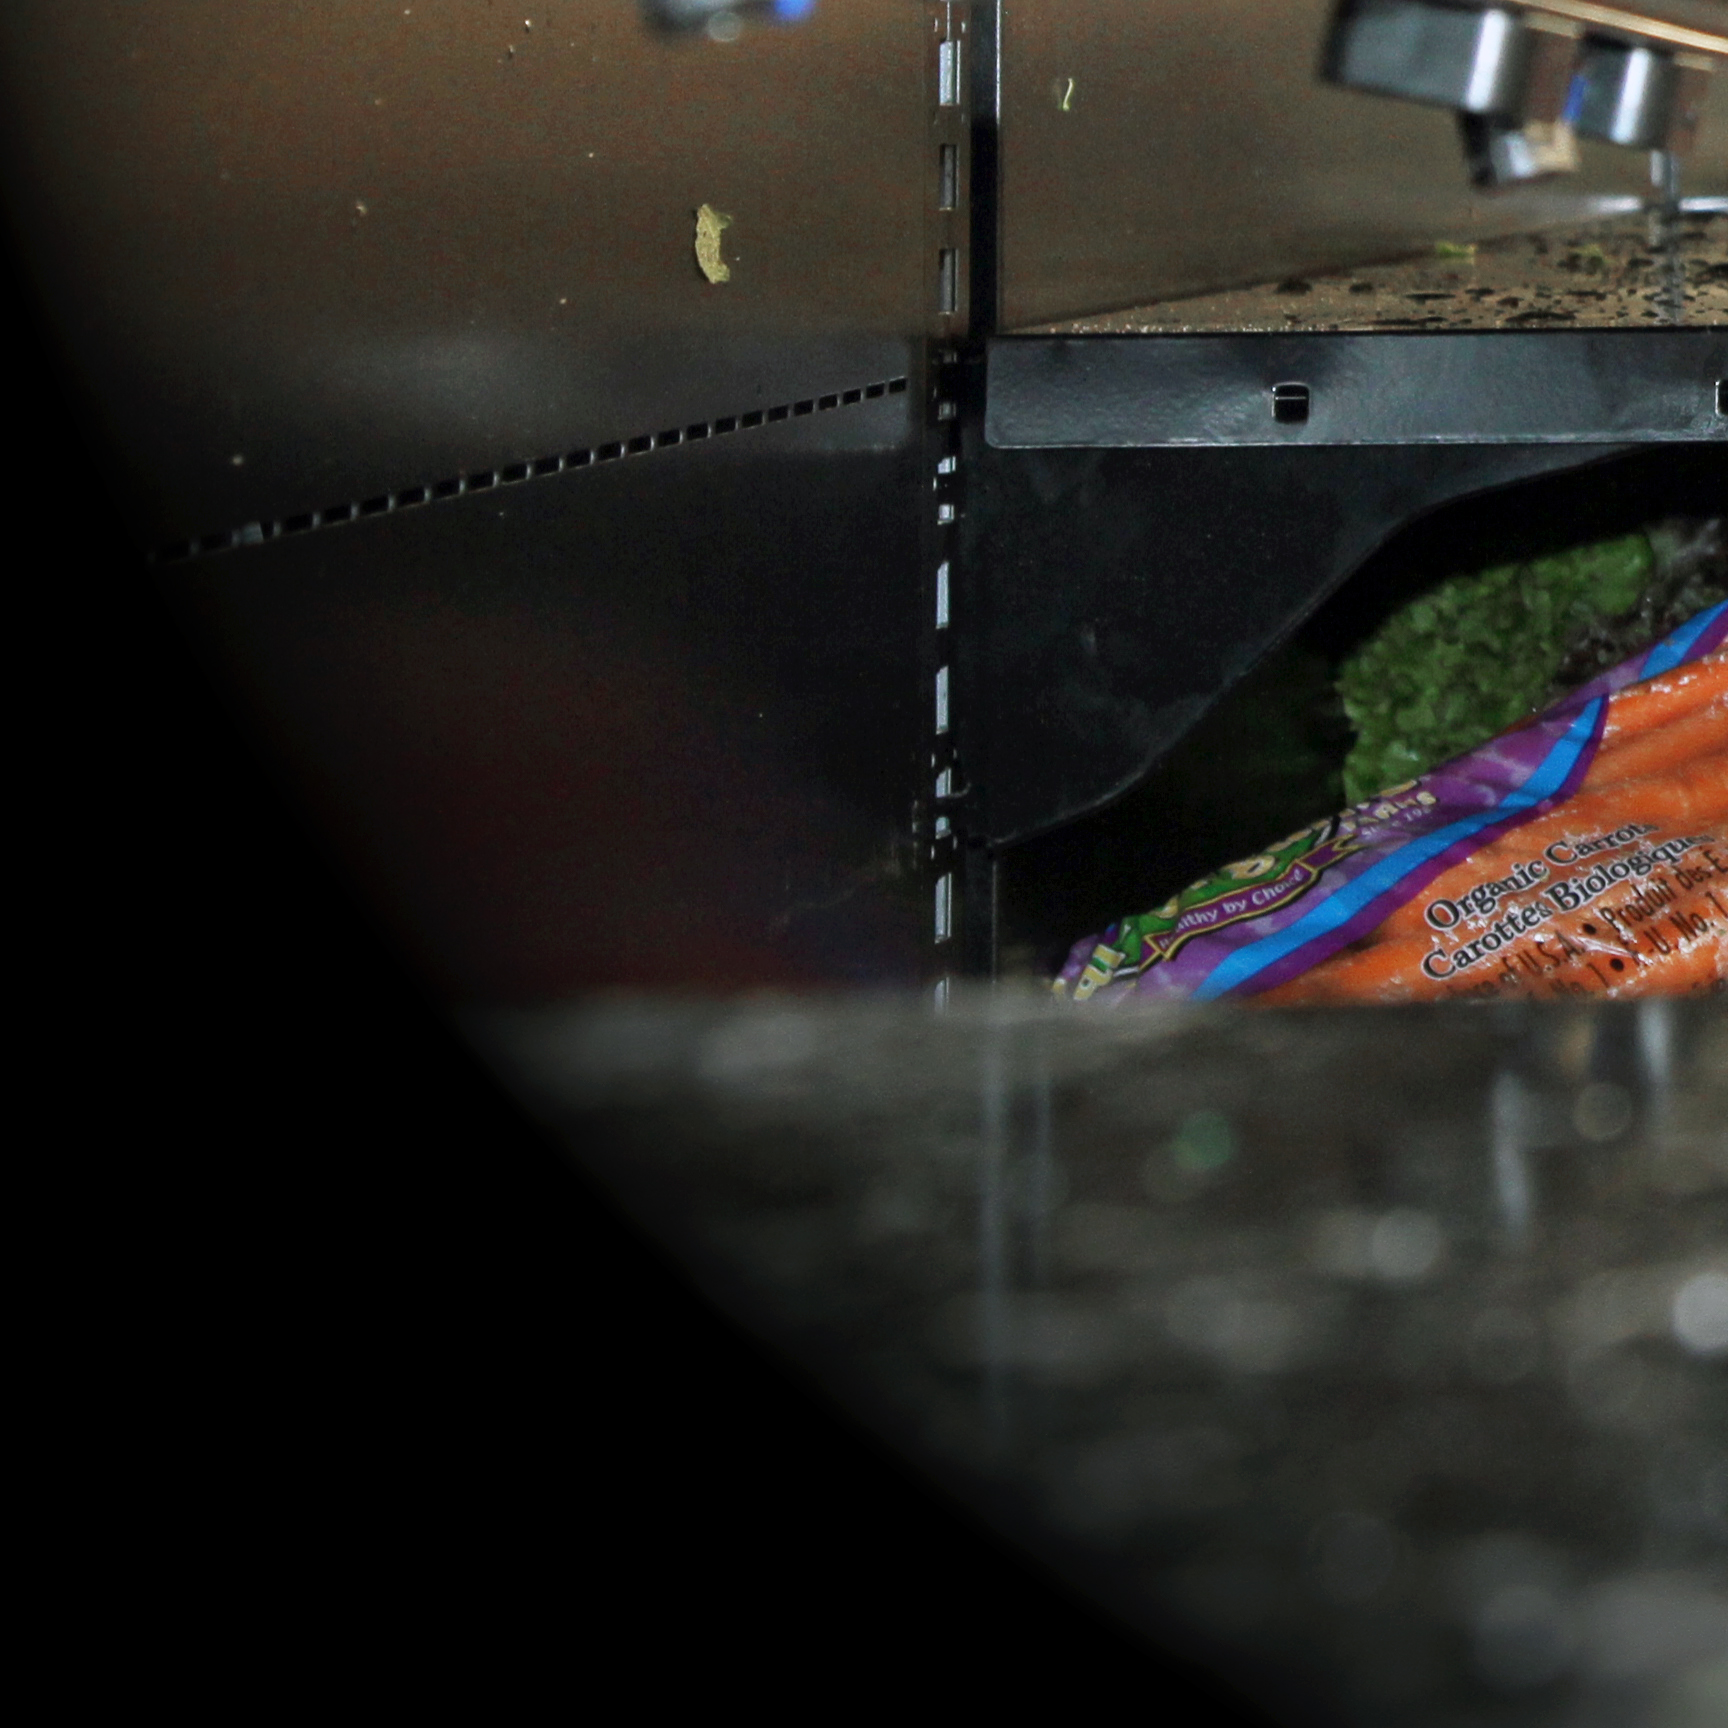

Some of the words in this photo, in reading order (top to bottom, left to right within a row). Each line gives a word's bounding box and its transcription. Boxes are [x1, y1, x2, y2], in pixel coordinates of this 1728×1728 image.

[1223, 896, 1248, 917] by
[1425, 860, 1548, 933] Organic
[1420, 900, 1554, 981] Carottes
